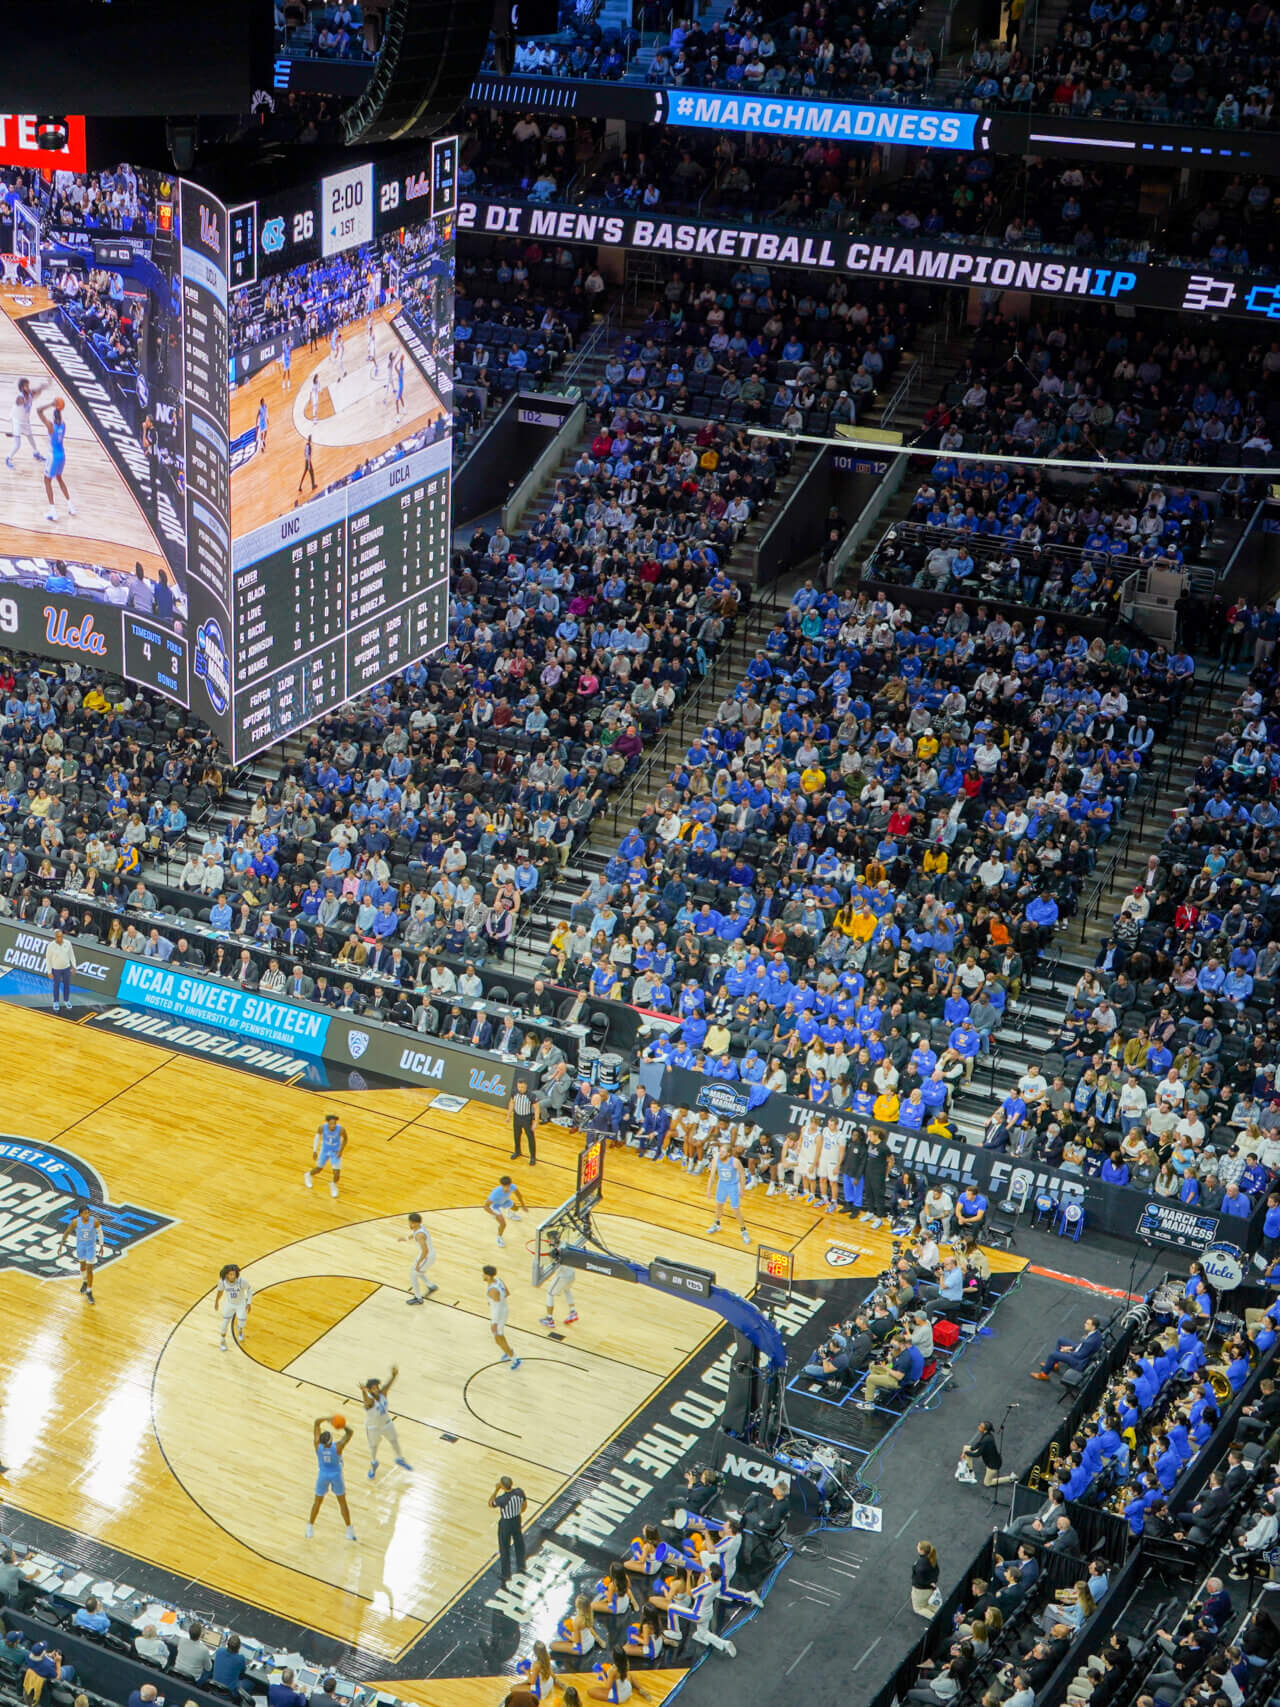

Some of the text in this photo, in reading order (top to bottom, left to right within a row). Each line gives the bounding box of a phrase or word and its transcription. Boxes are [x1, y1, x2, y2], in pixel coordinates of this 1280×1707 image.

[676, 96, 961, 143] #MARCHMADNESS
[332, 181, 363, 213] 2:00
[380, 181, 399, 212] 29
[293, 210, 314, 243] 26
[340, 218, 355, 237] 1ST
[485, 206, 1137, 297] DI MEN'S BASKETBALL CHAMPIONSHIP
[523, 410, 542, 423] 102
[389, 465, 411, 487] UCLA
[833, 456, 852, 469] 101
[281, 517, 300, 540] UNC
[43, 605, 107, 656] Ucla
[142, 642, 179, 675] 4 3
[76, 961, 111, 979] ACC
[126, 964, 322, 1038] NCAA SWEET SIXTEEN
[144, 994, 295, 1044] HOSTED BY UNIVERSITY OF PENNSYLVANIA
[95, 1007, 309, 1076] PHILADELPHIA
[400, 1049, 445, 1080] UCLA
[469, 1068, 506, 1097] Ucla
[886, 1131, 979, 1186] FINAL
[1158, 1207, 1197, 1226] MARCH
[1161, 1218, 1214, 1241] MADNESS
[1204, 1261, 1234, 1280] Ucla
[623, 1423, 700, 1480] THE
